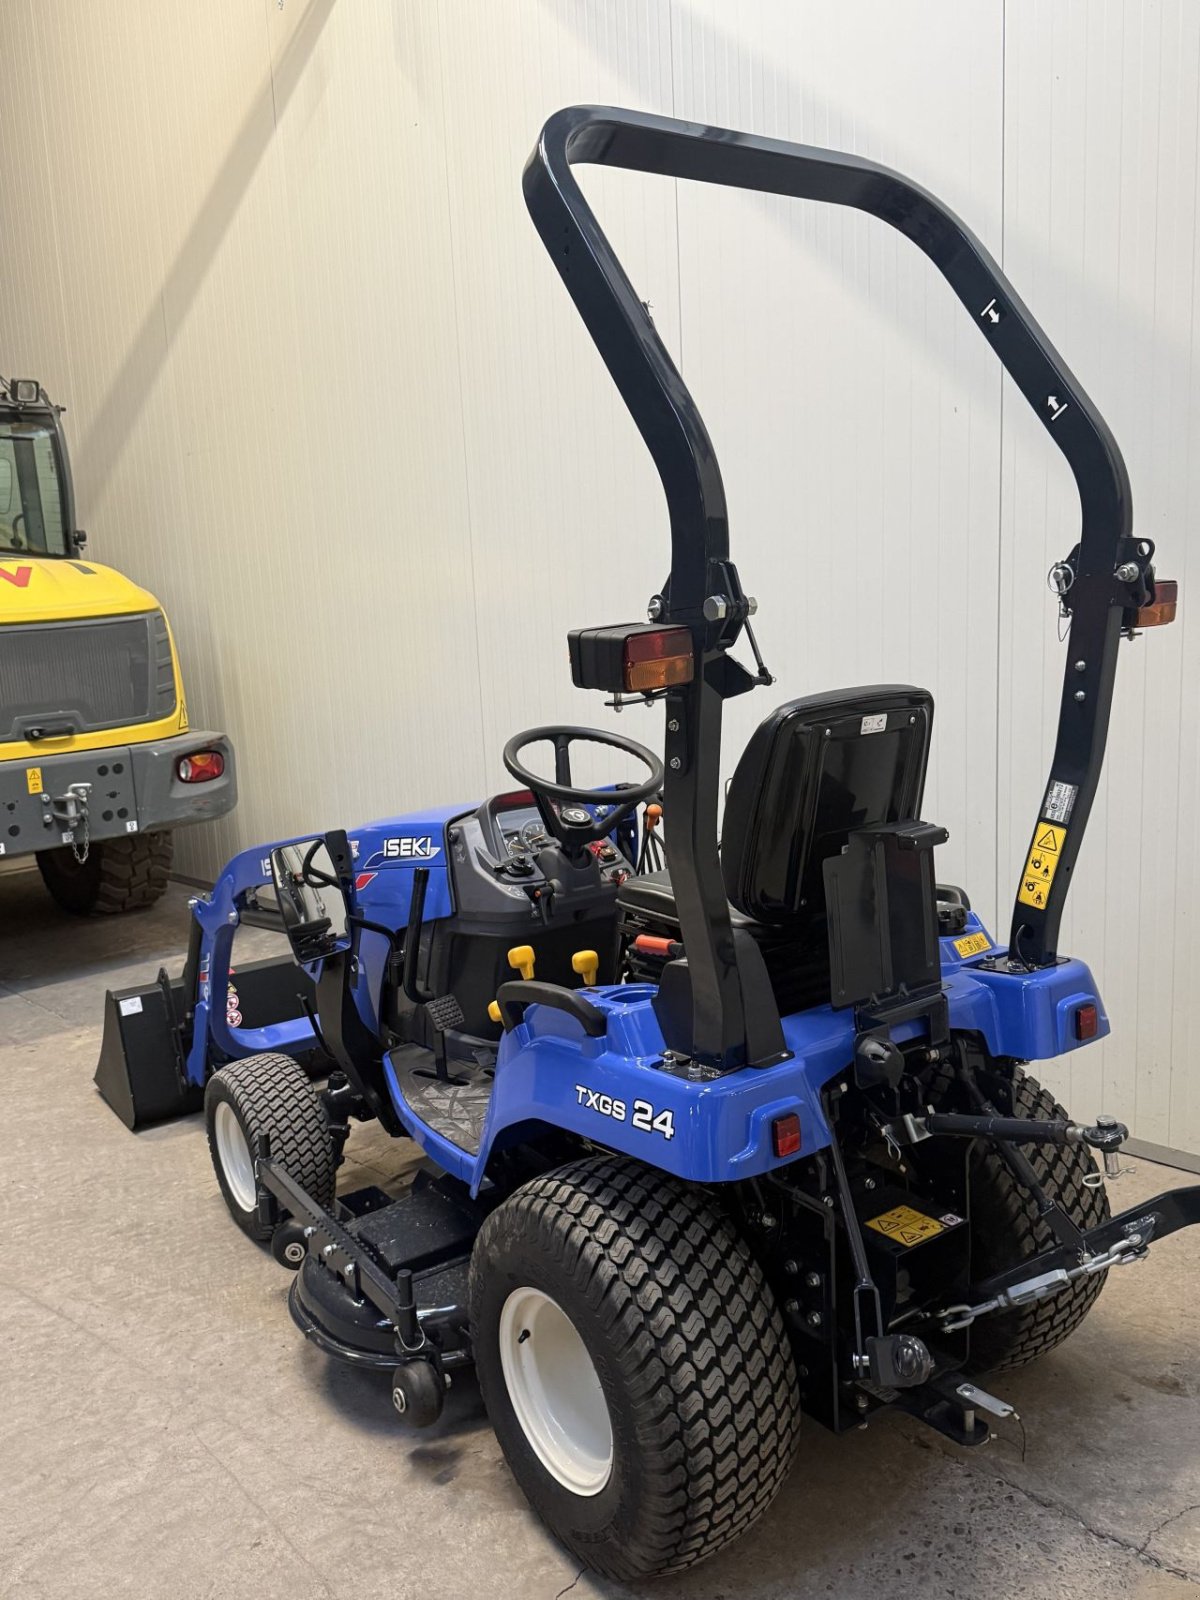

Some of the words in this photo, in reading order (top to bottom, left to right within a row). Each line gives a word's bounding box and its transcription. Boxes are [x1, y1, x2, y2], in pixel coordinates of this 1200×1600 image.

[383, 836, 432, 857] ISEKI
[575, 1084, 627, 1121] TXGS
[632, 1099, 675, 1140] 24
